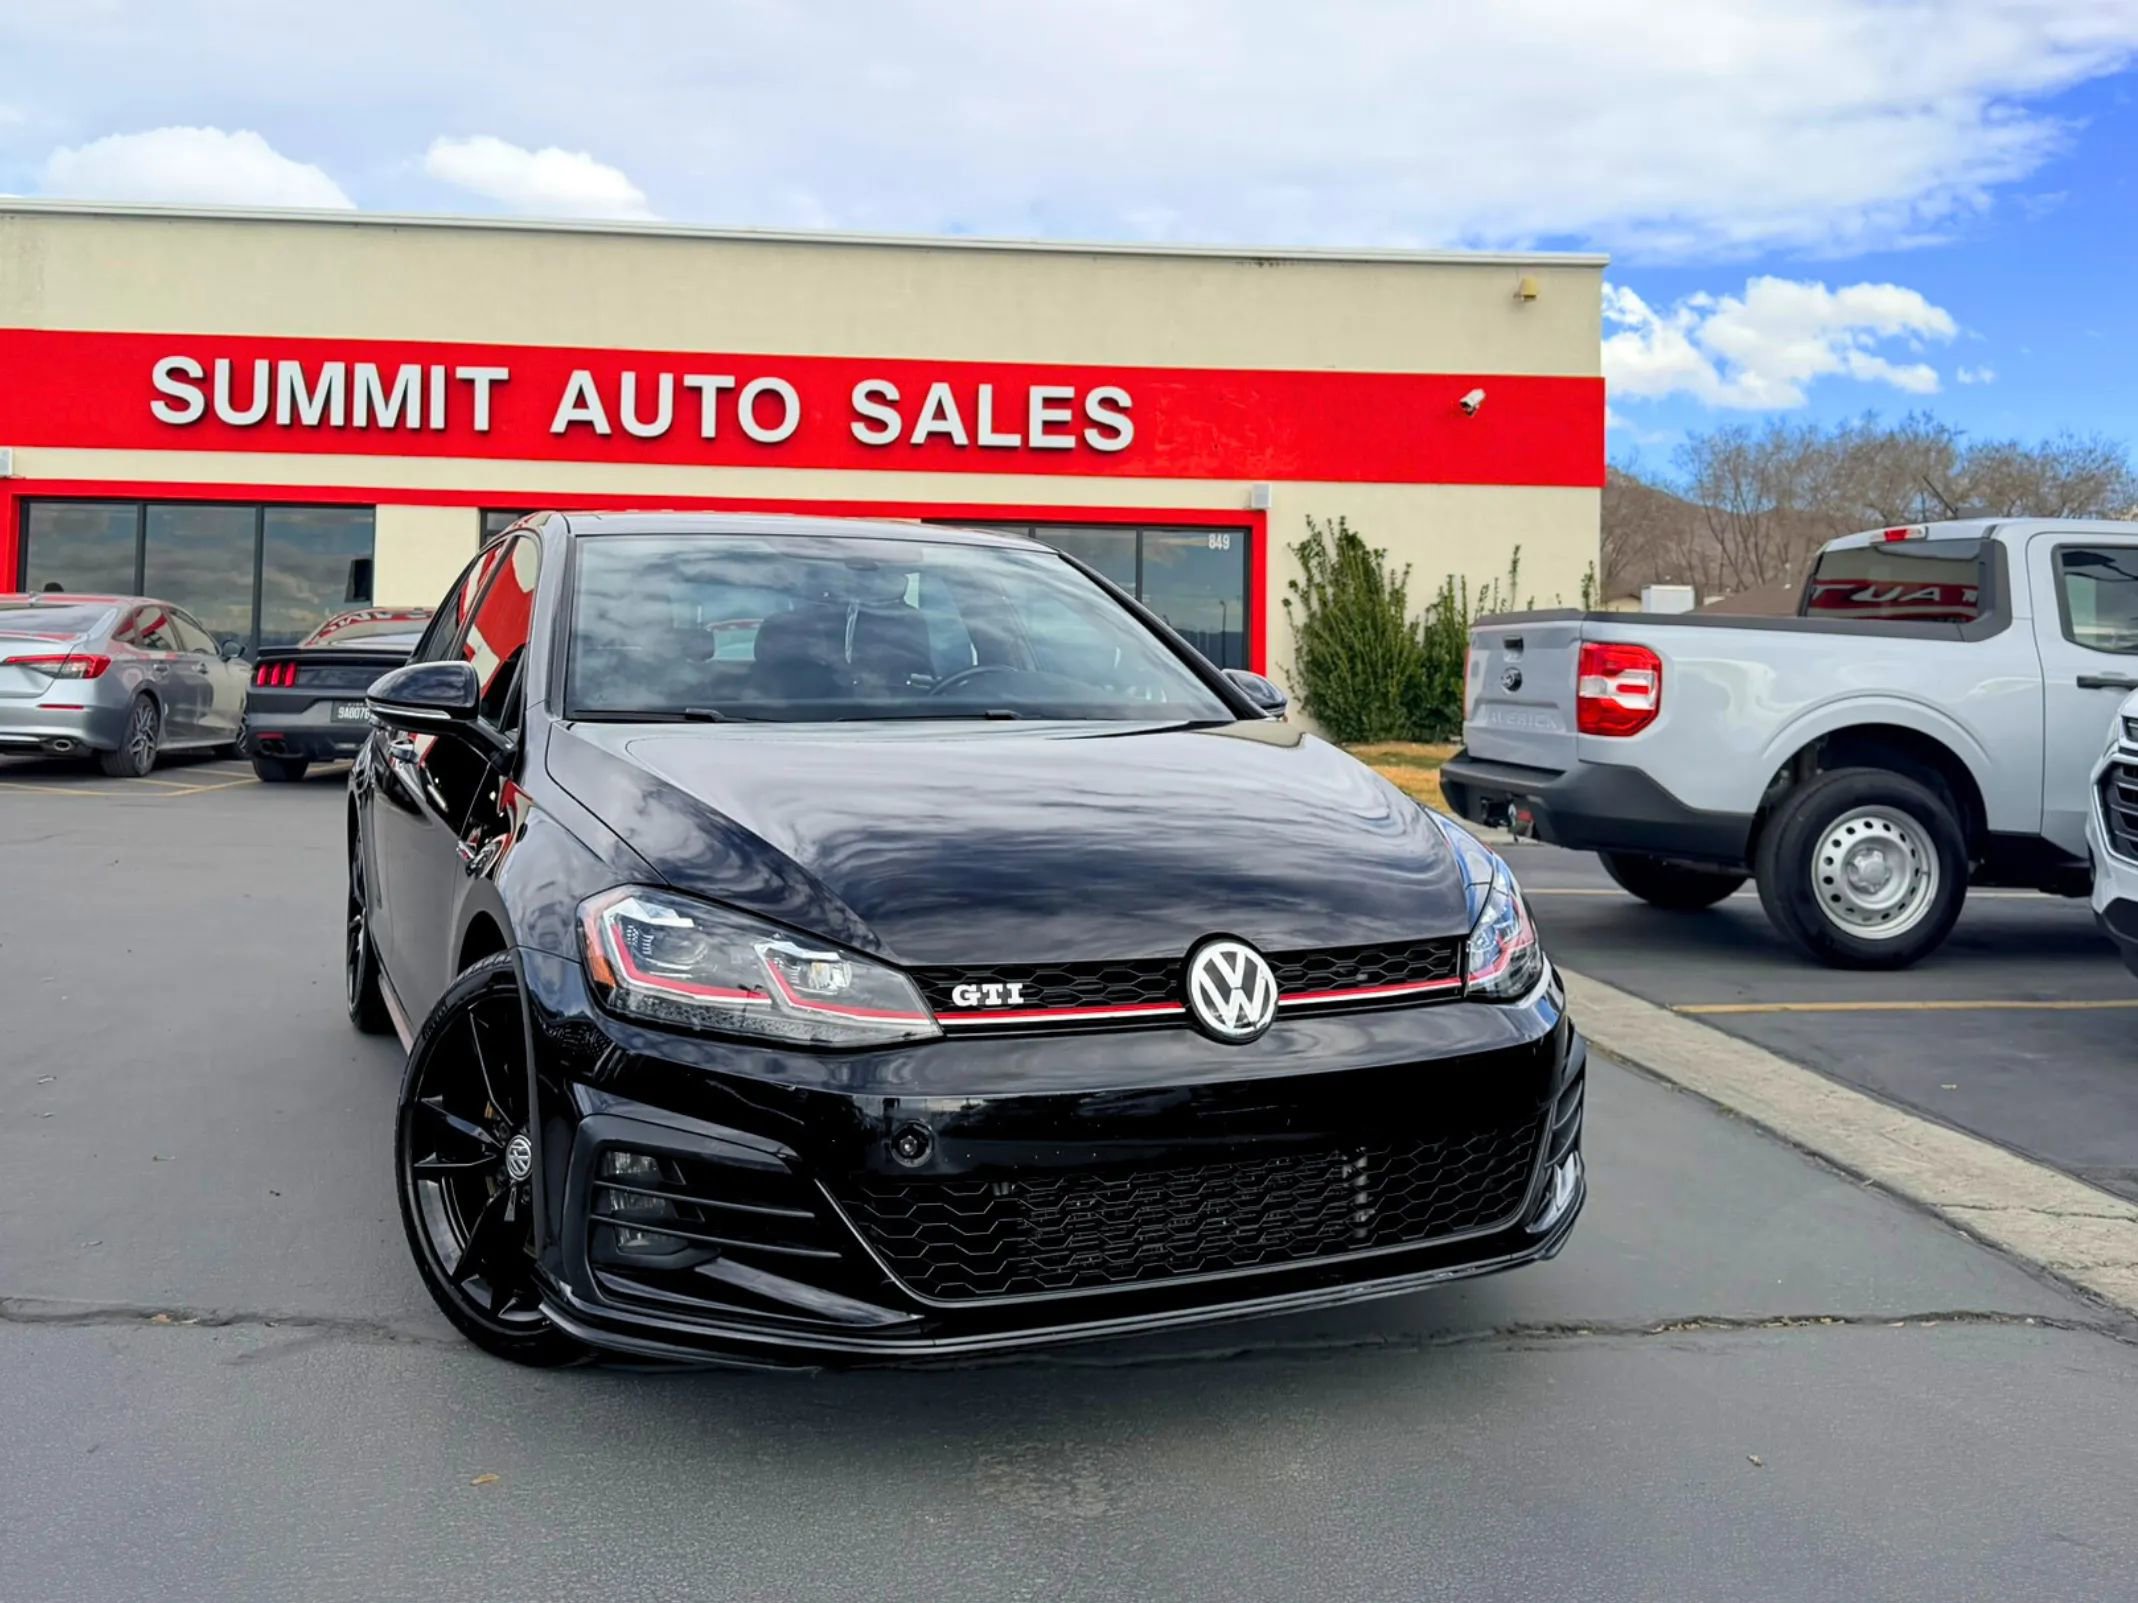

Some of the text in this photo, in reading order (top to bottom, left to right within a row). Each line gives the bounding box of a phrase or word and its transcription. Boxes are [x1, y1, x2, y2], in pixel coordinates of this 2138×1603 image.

[150, 355, 1134, 451] SUMMIT AUTO SALES
[1208, 533, 1231, 550] 849
[951, 983, 1025, 1007] GTI
[1191, 942, 1277, 1035] VW
